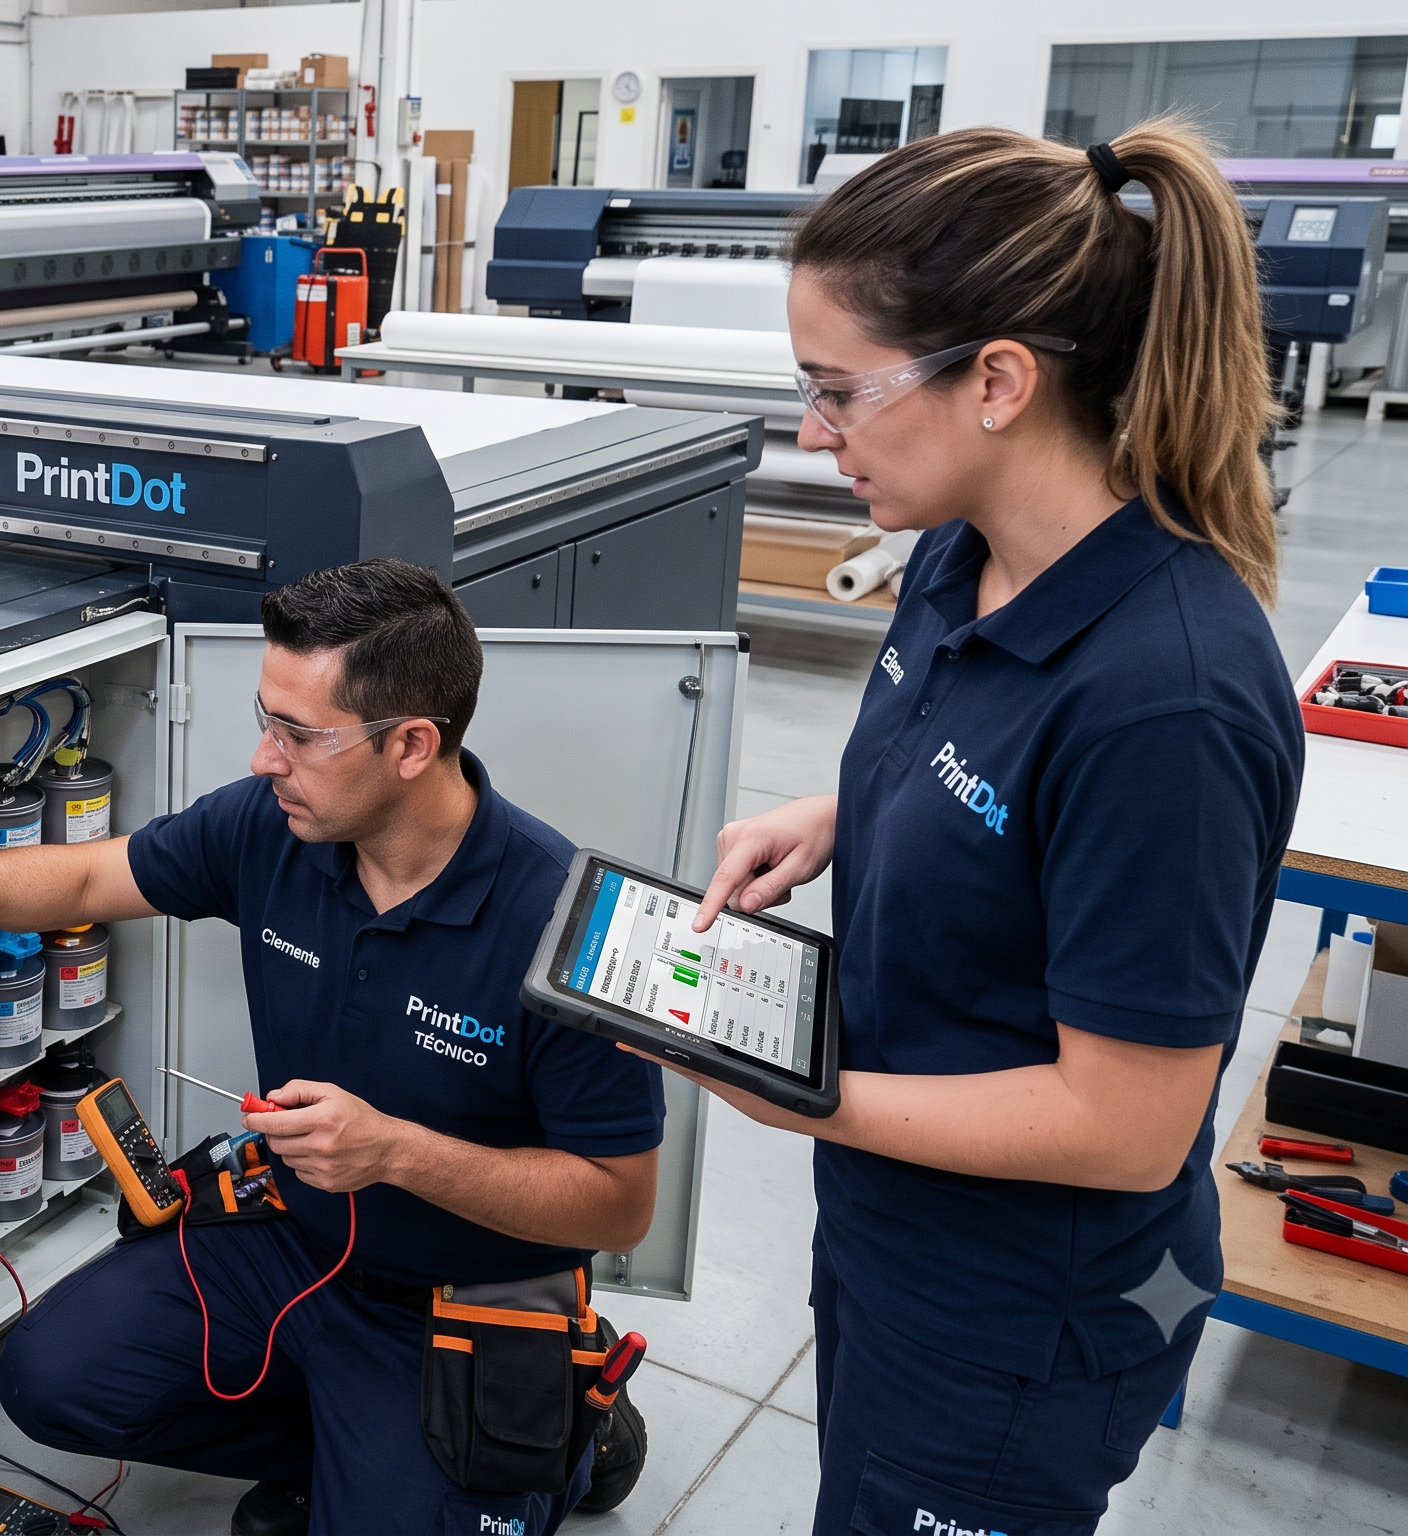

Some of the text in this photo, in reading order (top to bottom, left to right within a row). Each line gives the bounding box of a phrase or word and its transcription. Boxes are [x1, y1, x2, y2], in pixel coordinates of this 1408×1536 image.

[17, 452, 186, 515] PrintDot
[881, 646, 904, 685] Elena
[930, 741, 1008, 835] PrintDot
[262, 928, 320, 968] Clemente
[406, 995, 505, 1046] PrintDot
[414, 1031, 487, 1066] TÉCNICO
